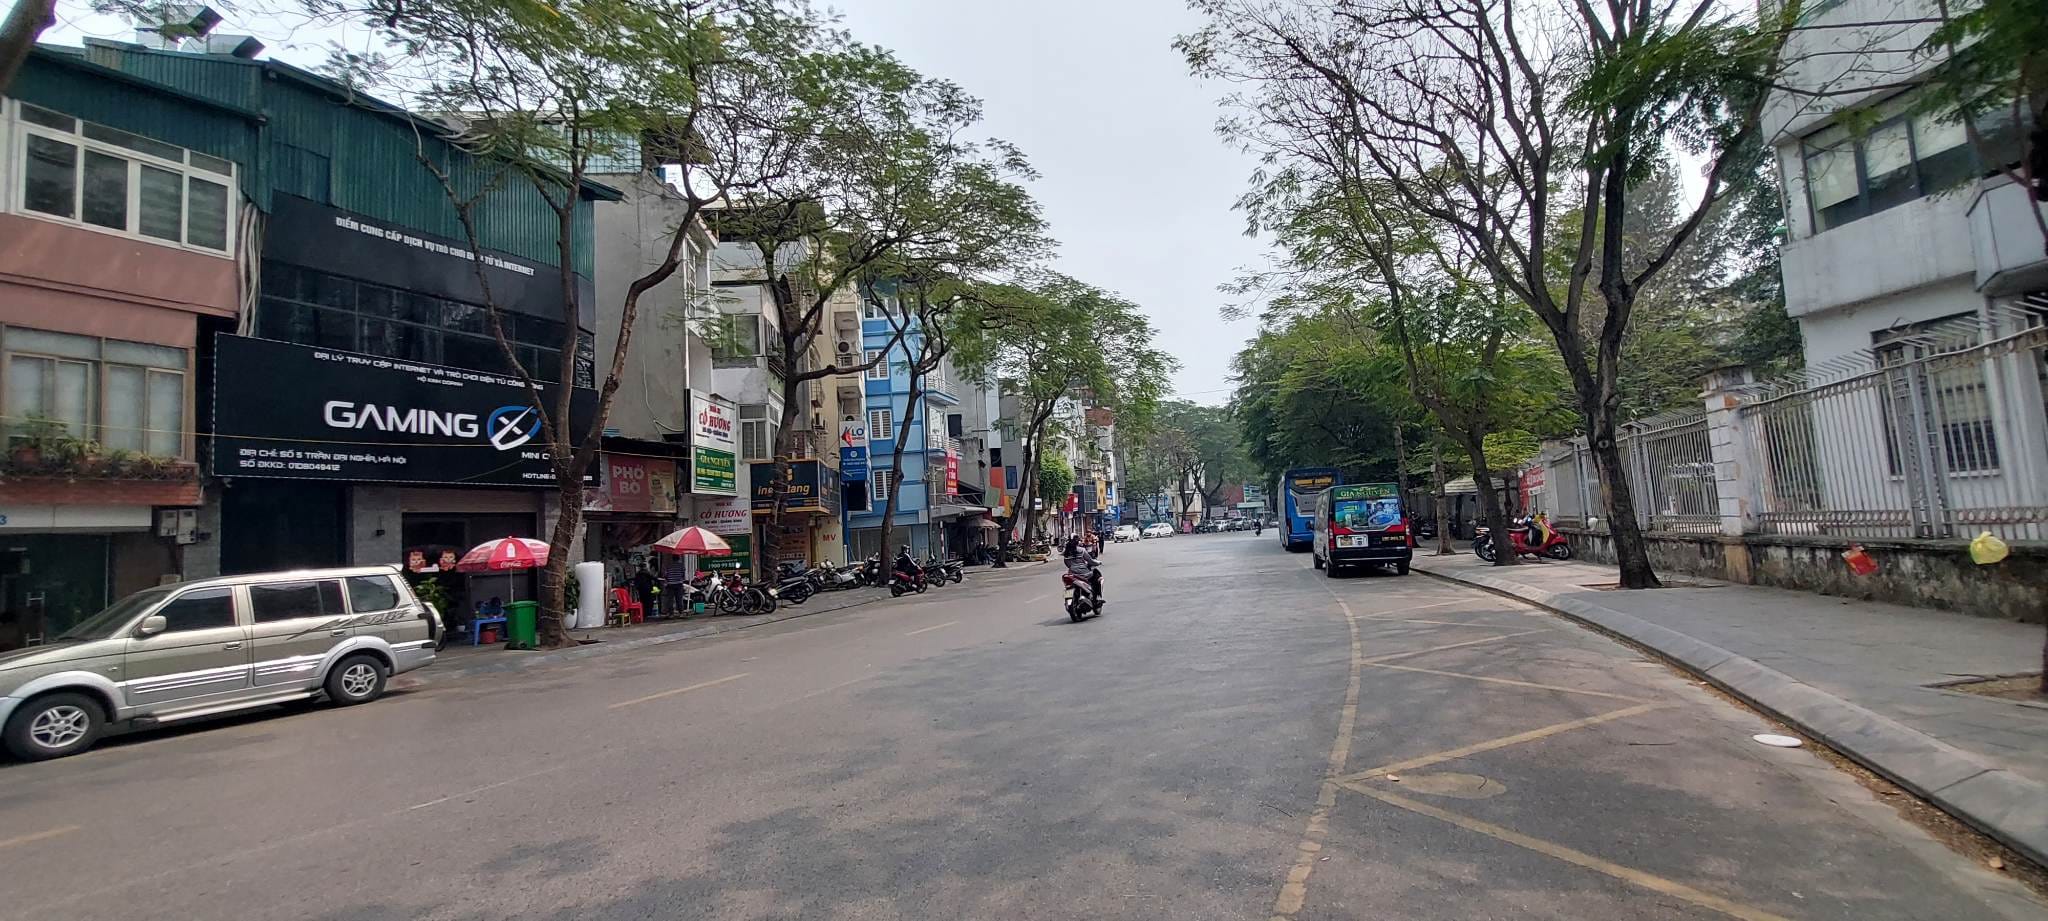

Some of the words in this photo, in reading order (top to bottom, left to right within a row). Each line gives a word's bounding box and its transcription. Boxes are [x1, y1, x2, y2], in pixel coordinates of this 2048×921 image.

[360, 223, 384, 237] CUNG
[385, 230, 402, 241] CẤP
[403, 235, 423, 246] DỊCH
[346, 356, 372, 365] TRUY
[393, 363, 432, 374] INTERNET
[324, 400, 479, 438] GAMING
[280, 449, 294, 458] SỐ
[305, 450, 331, 460] TRẦN
[521, 452, 540, 460] MINI
[239, 458, 255, 468] SỐ
[612, 464, 645, 480] PHỞ
